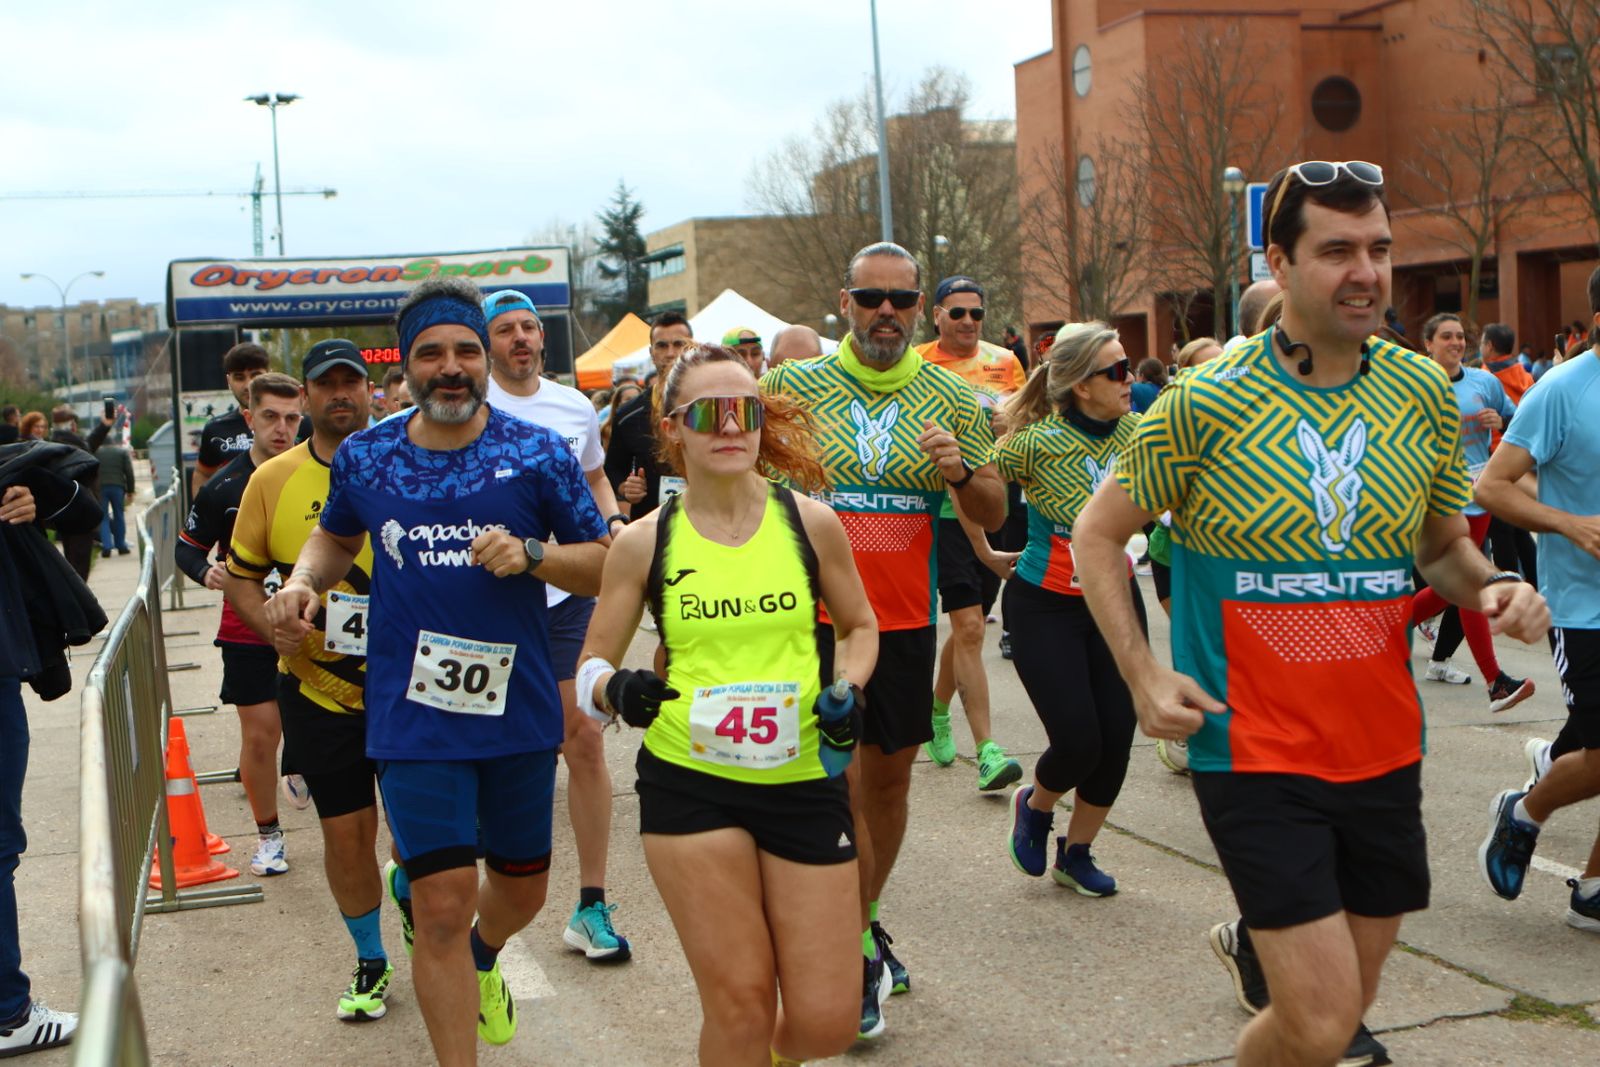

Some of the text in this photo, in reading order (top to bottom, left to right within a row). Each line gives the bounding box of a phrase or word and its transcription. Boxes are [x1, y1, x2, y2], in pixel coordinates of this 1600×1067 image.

[342, 612, 368, 639] 4
[434, 658, 490, 694] 30
[715, 706, 779, 744] 45
